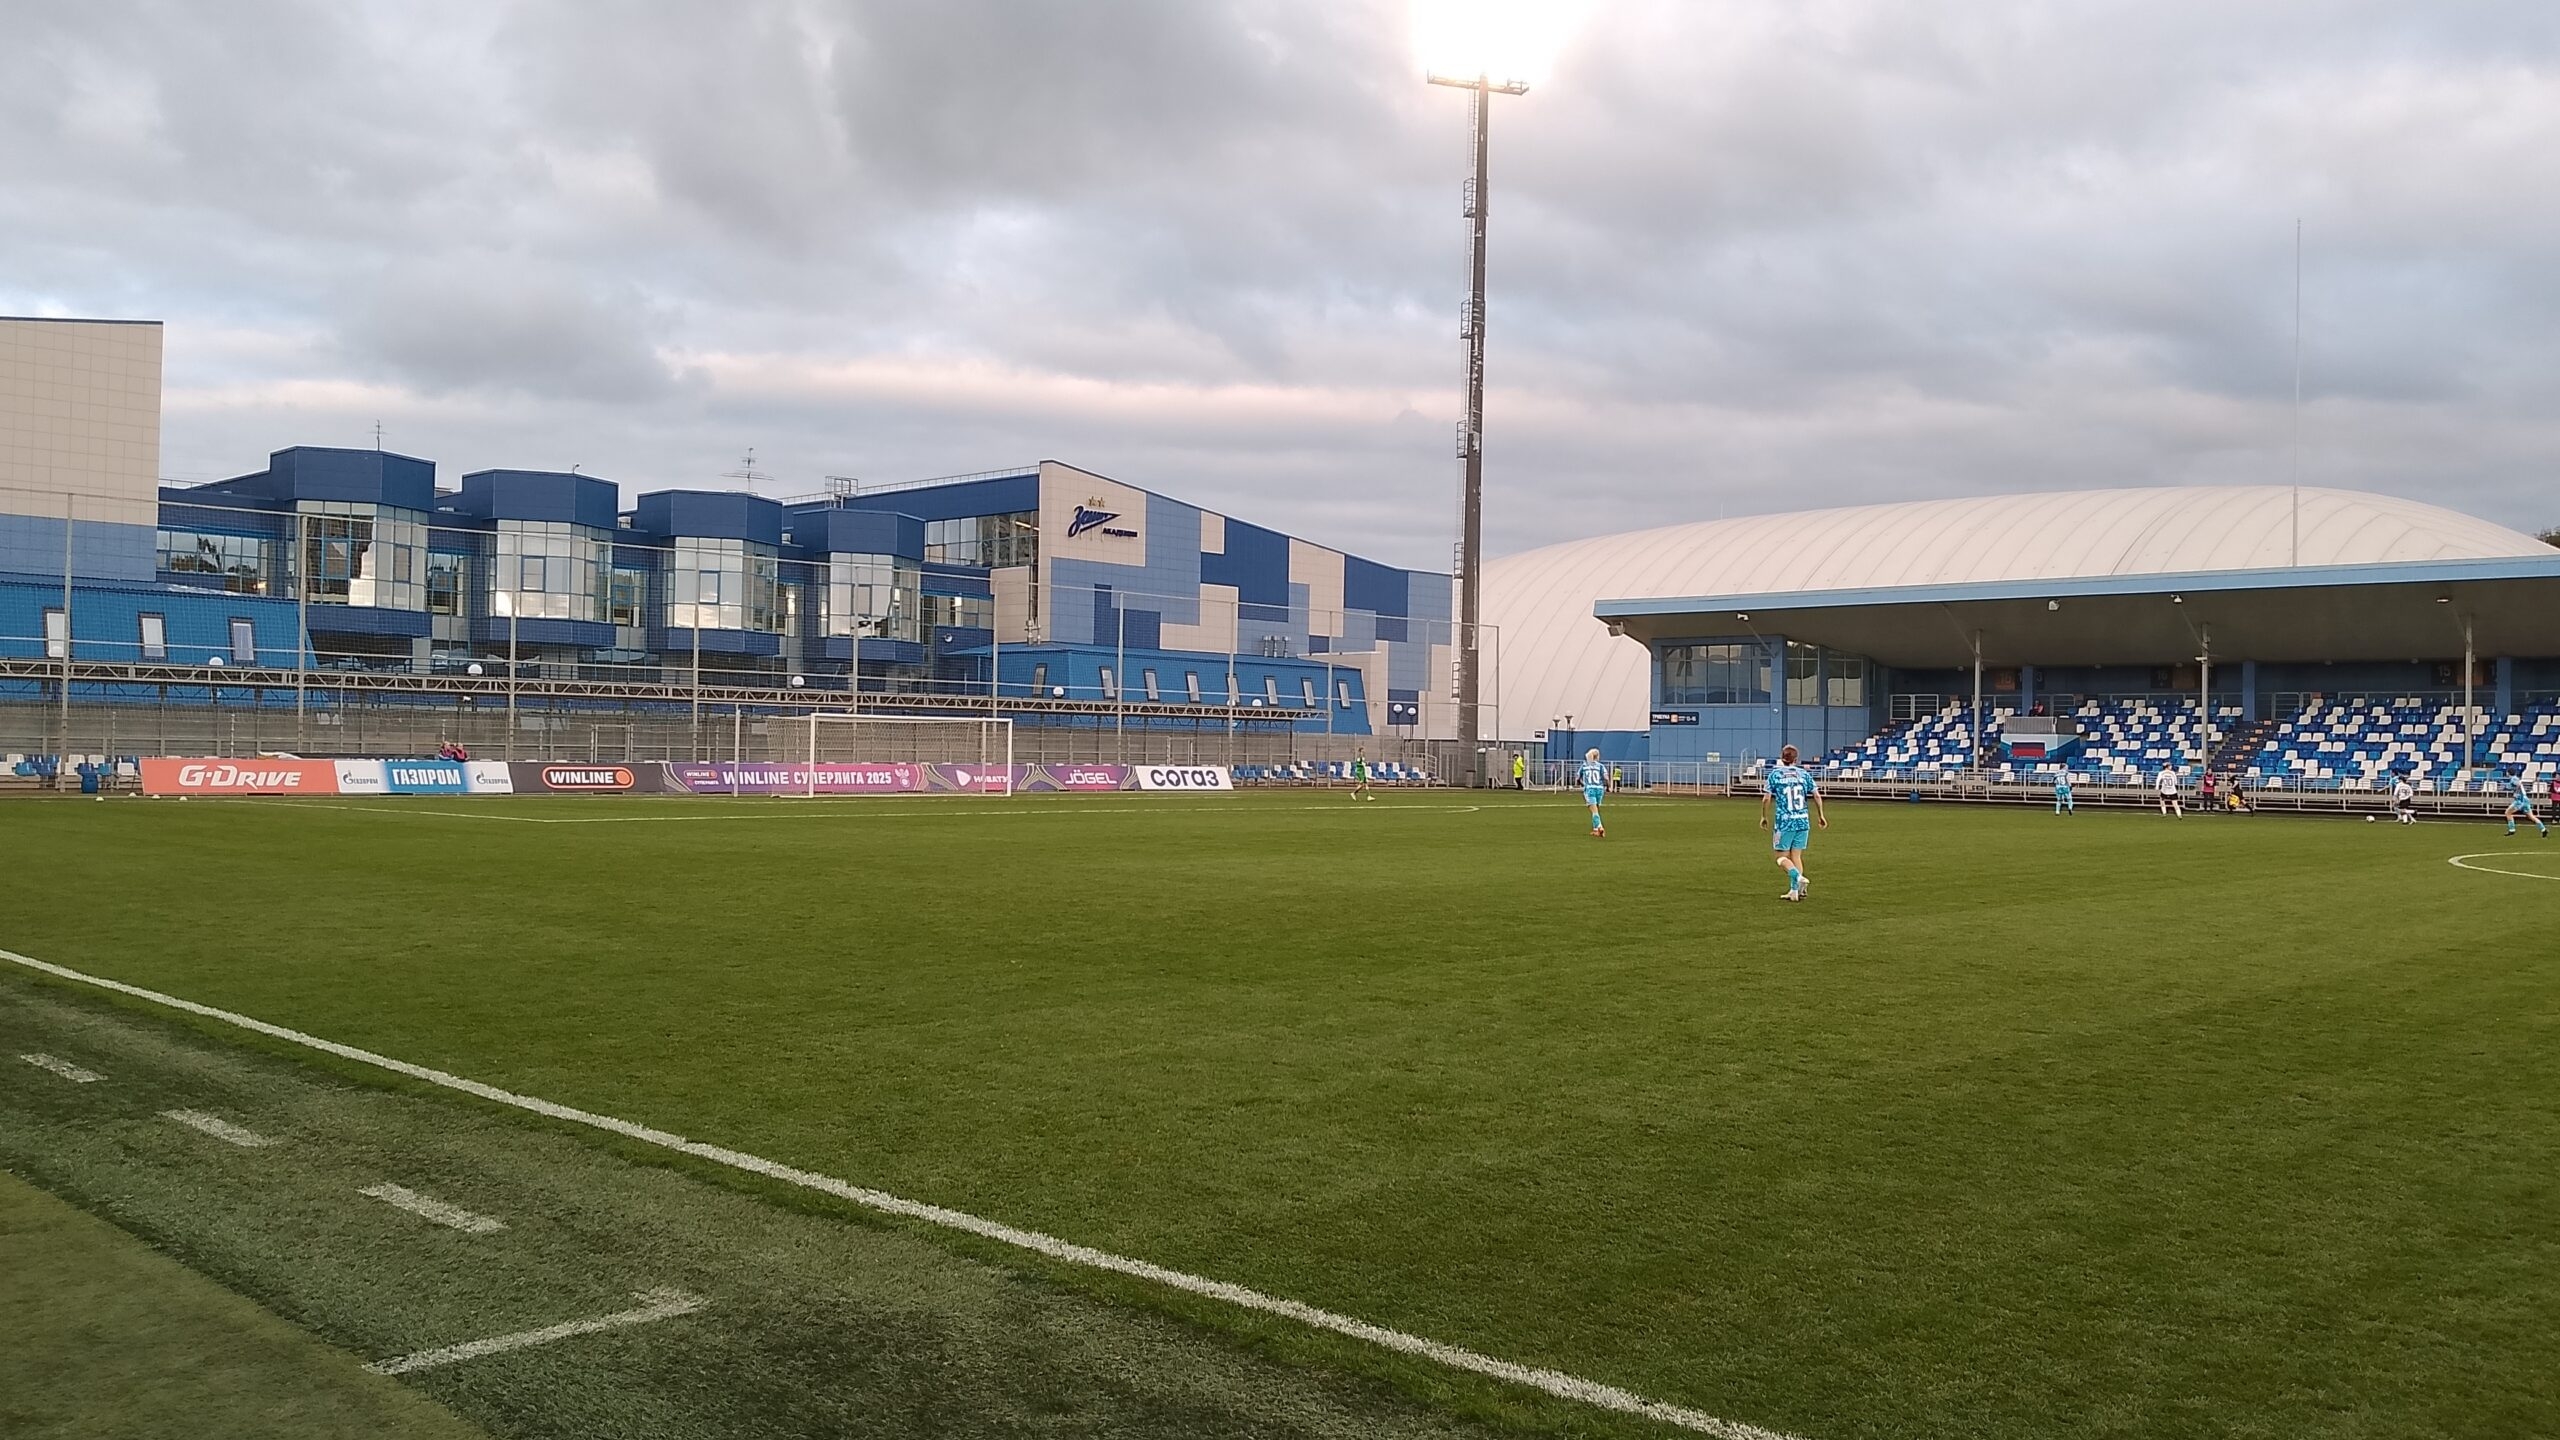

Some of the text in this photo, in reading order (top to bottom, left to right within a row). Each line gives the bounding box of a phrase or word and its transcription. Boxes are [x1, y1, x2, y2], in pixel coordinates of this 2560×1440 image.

[391, 768, 462, 786] ГАЗПРОМ
[550, 771, 614, 784] WINLINE
[722, 771, 789, 785] WINLINE
[866, 771, 892, 785] 2025
[1065, 769, 1118, 785] JÖGEL
[1783, 785, 1805, 811] 15
